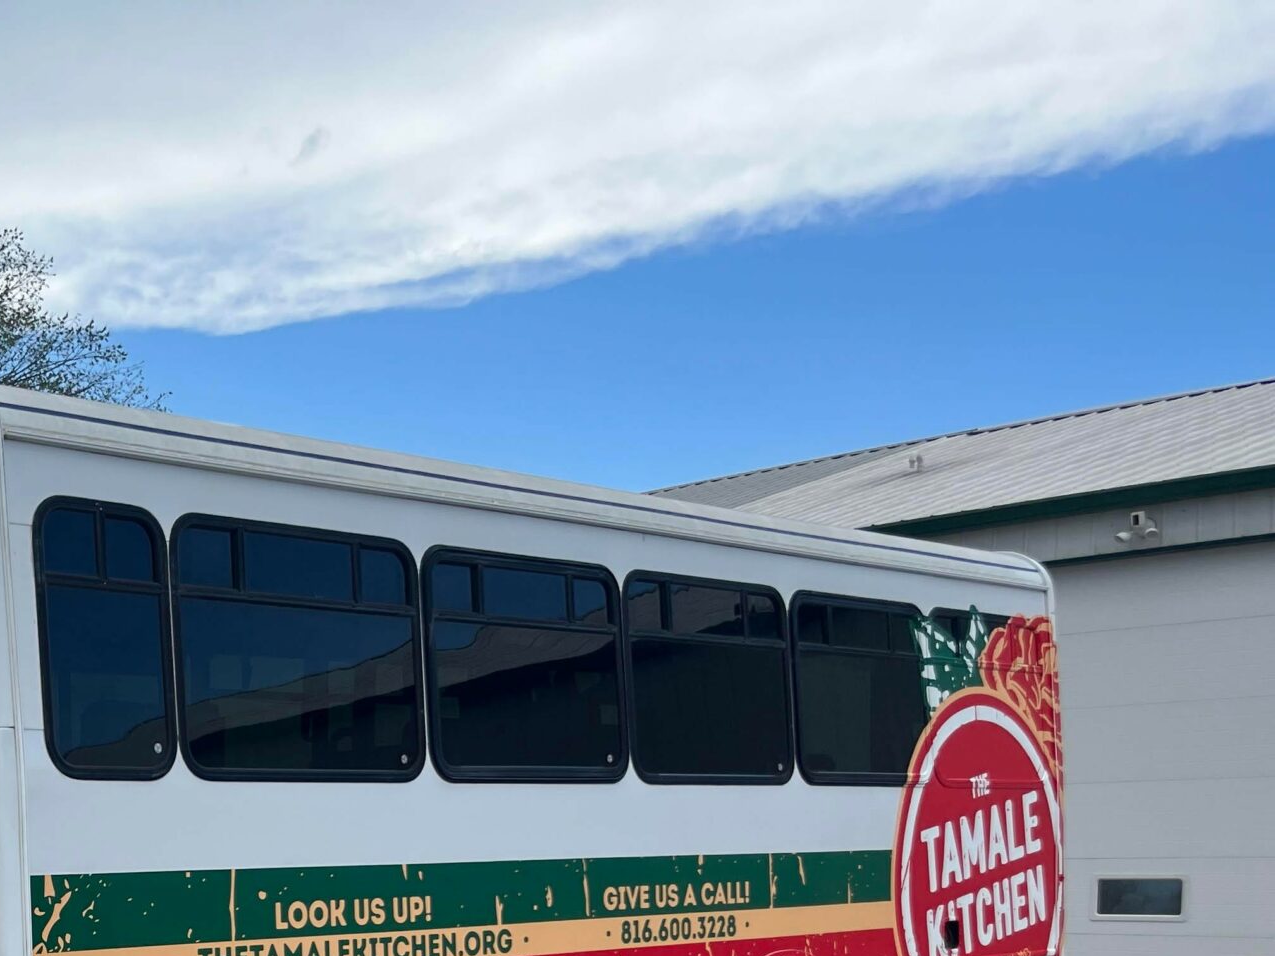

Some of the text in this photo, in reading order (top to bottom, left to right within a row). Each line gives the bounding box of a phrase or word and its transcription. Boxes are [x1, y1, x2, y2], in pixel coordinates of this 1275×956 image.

[969, 772, 990, 799] THE
[920, 790, 1042, 893] TAMALE
[603, 881, 750, 911] GIVE US A CALL!
[275, 895, 432, 930] LOOK US UP!
[621, 914, 737, 944] 816.600.3228
